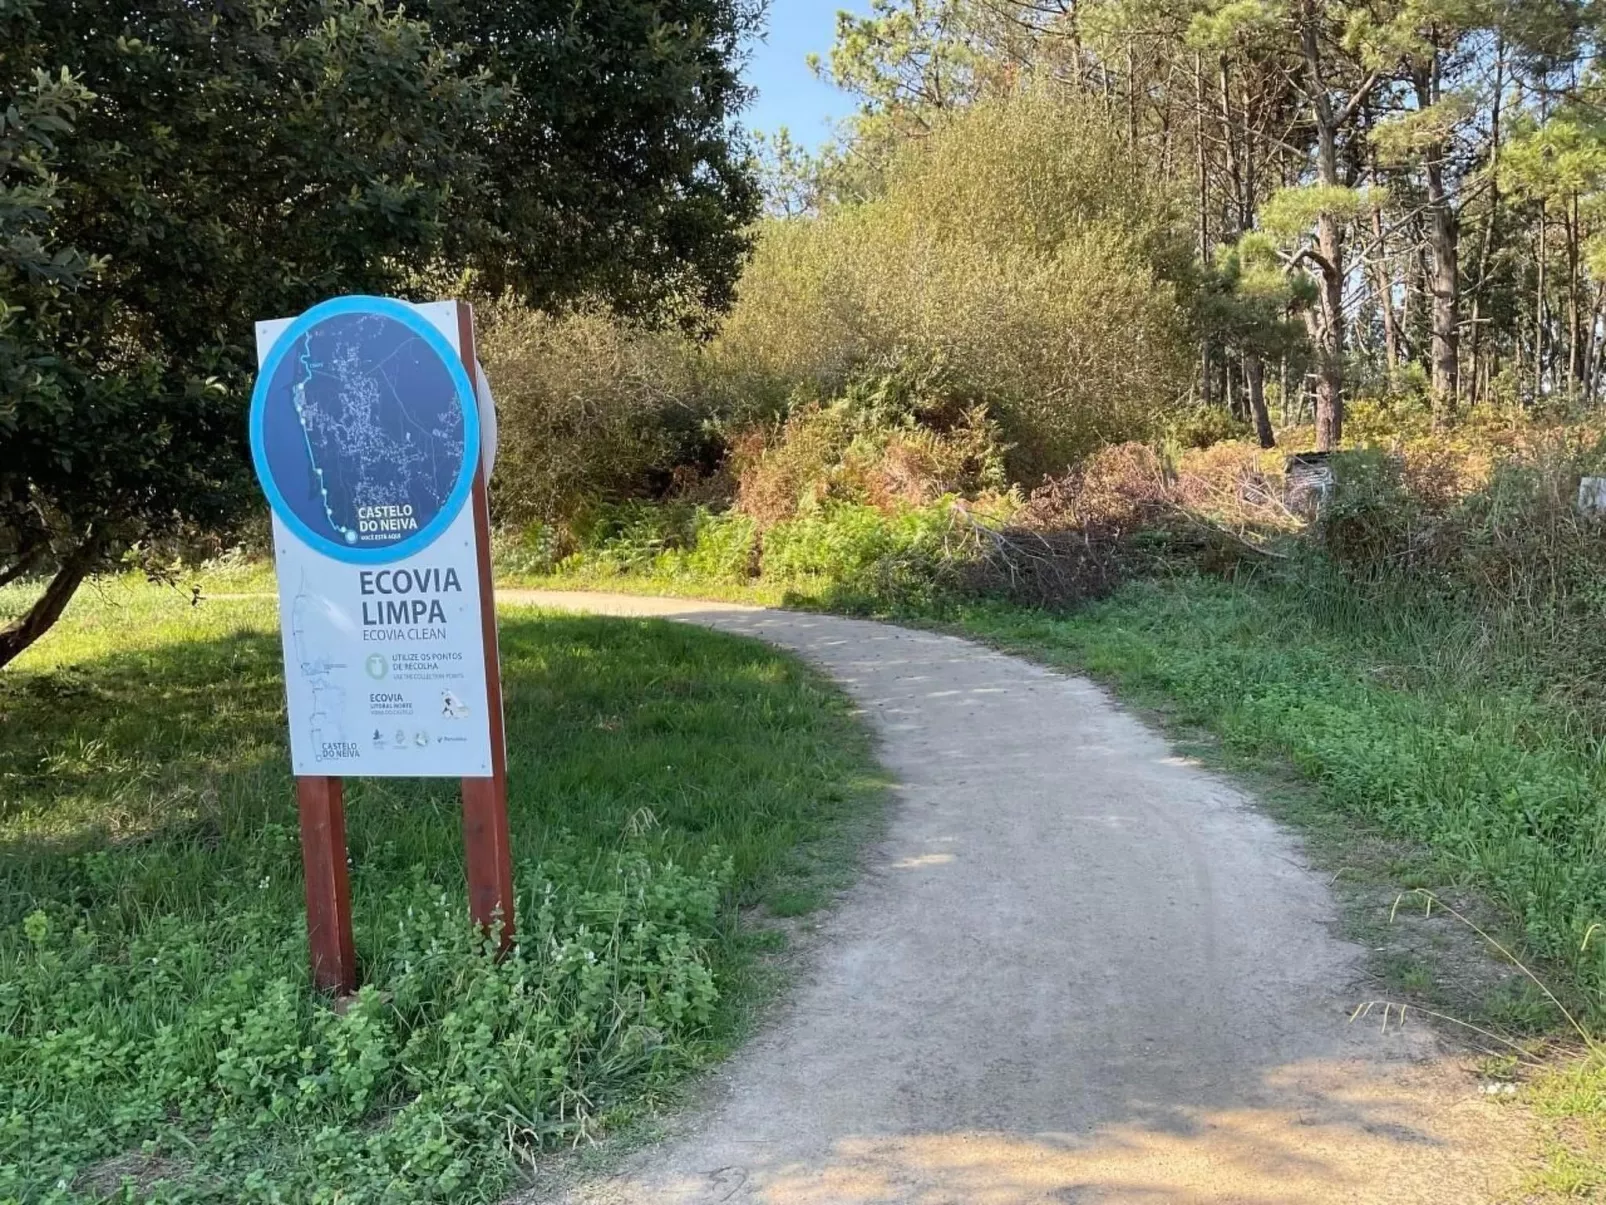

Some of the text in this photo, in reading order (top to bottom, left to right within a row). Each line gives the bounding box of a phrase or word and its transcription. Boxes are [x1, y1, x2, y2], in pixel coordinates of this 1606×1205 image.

[358, 505, 412, 518] CASTELO
[359, 518, 418, 532] DO NEIVA
[360, 567, 462, 595] ECOVIA
[362, 599, 447, 625] LIMPA
[363, 627, 446, 641] ECOVIA CLEAN
[392, 652, 463, 662] UTILIZE OS PONTOS
[393, 662, 439, 671] DE RECOLHA
[370, 693, 404, 702] ECOVIA
[322, 742, 357, 751] CASTELO
[323, 750, 361, 758] DO NEIVA
